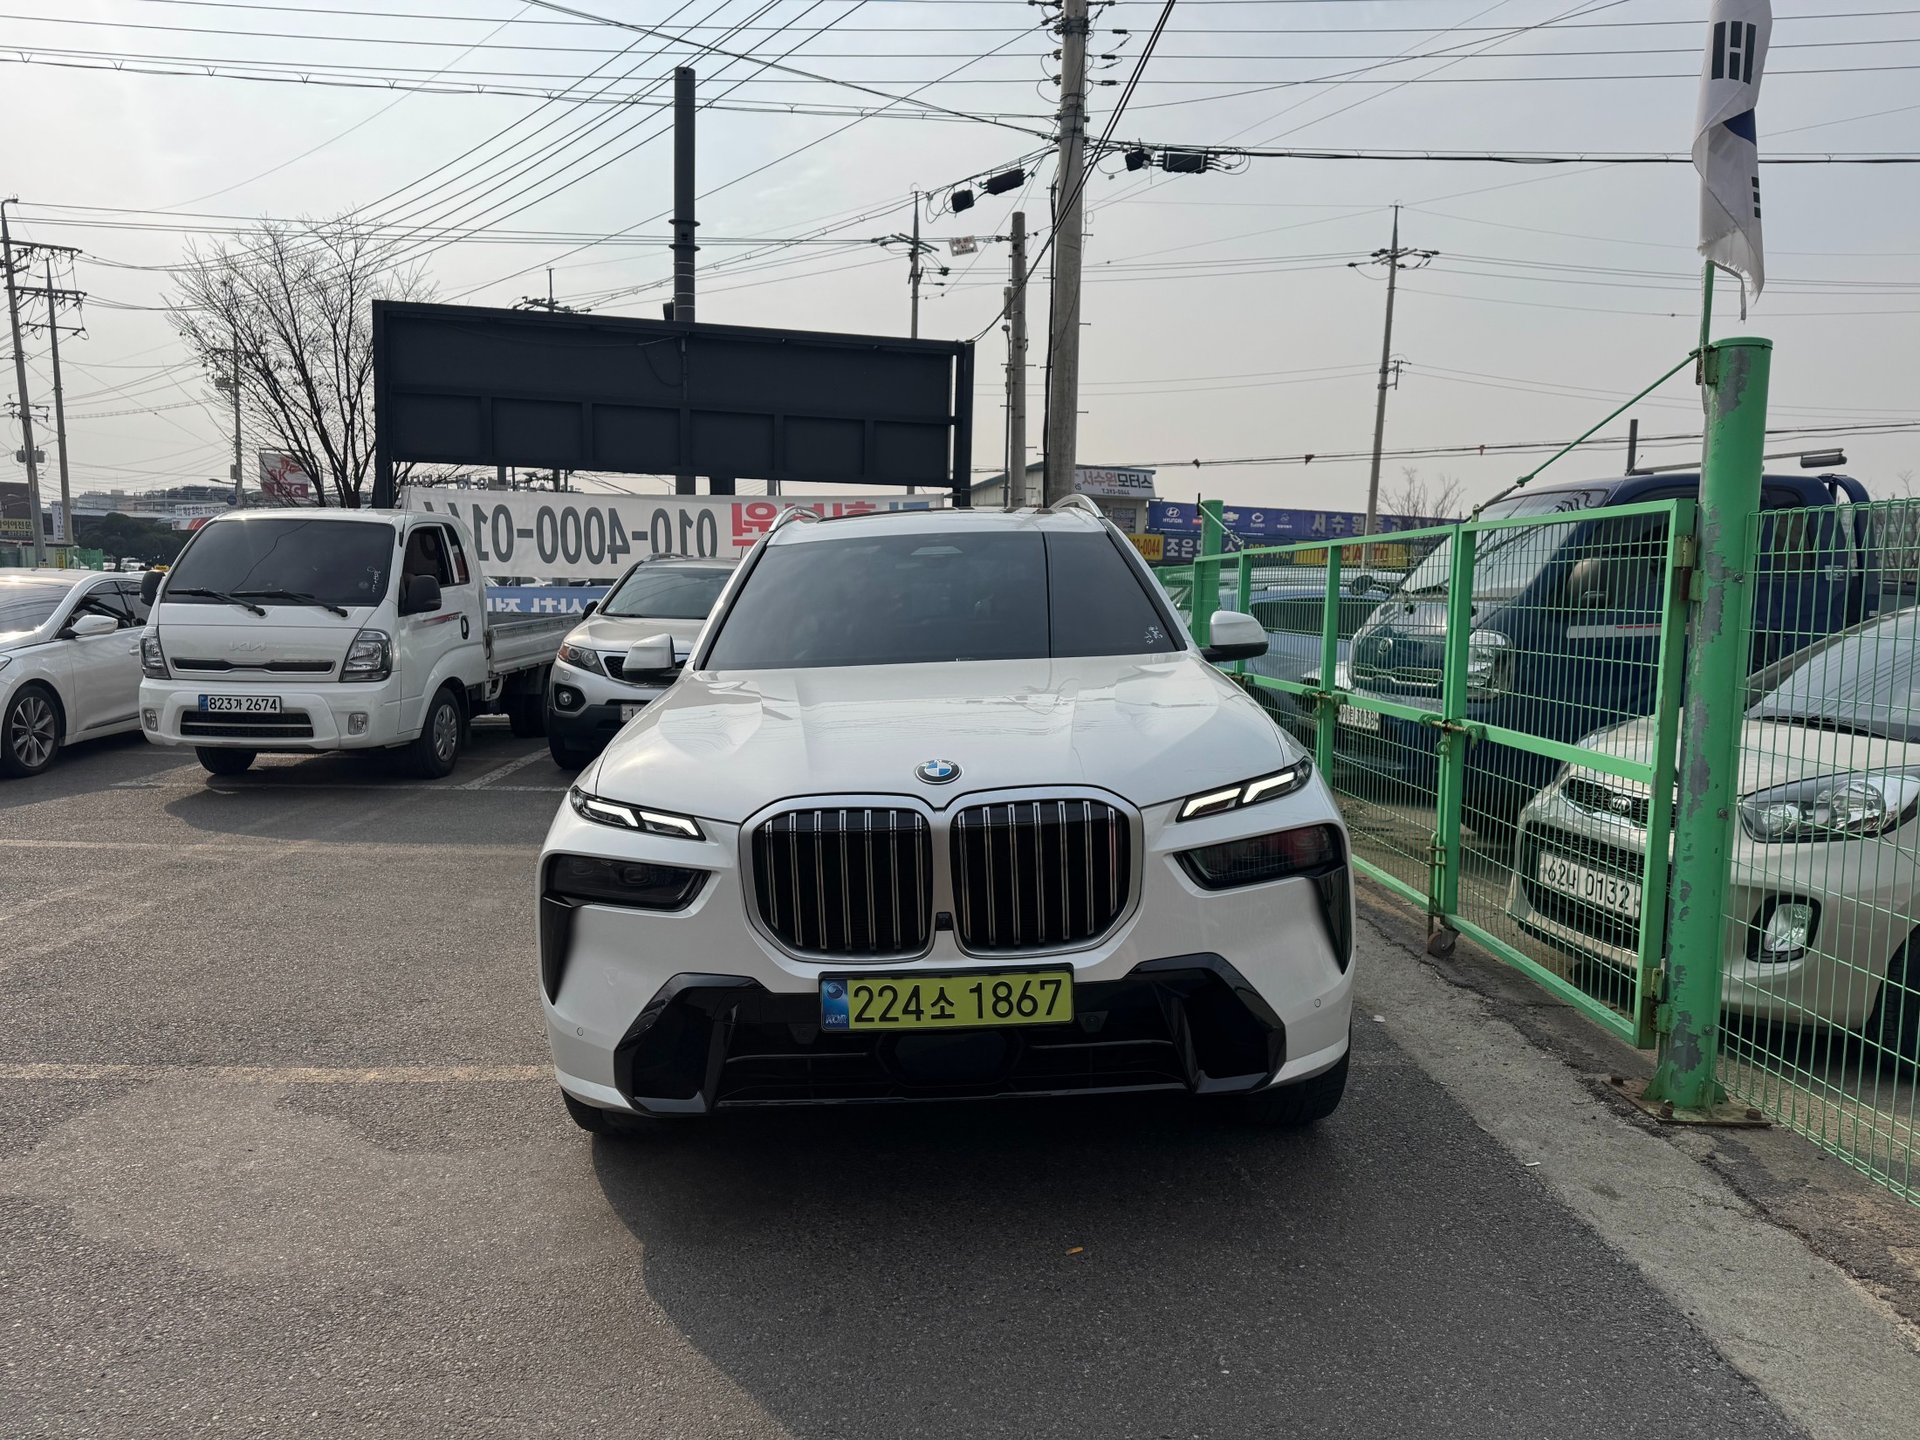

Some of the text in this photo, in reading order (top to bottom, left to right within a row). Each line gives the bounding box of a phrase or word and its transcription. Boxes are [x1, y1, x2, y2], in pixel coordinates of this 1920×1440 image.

[268, 468, 288, 483] SK
[1082, 470, 1153, 489] 서수원모터스
[273, 484, 301, 496] LPG
[209, 697, 278, 711] 823가 2674
[1547, 860, 1630, 910] 62나 0132
[853, 979, 1063, 1023] 224소 1867
